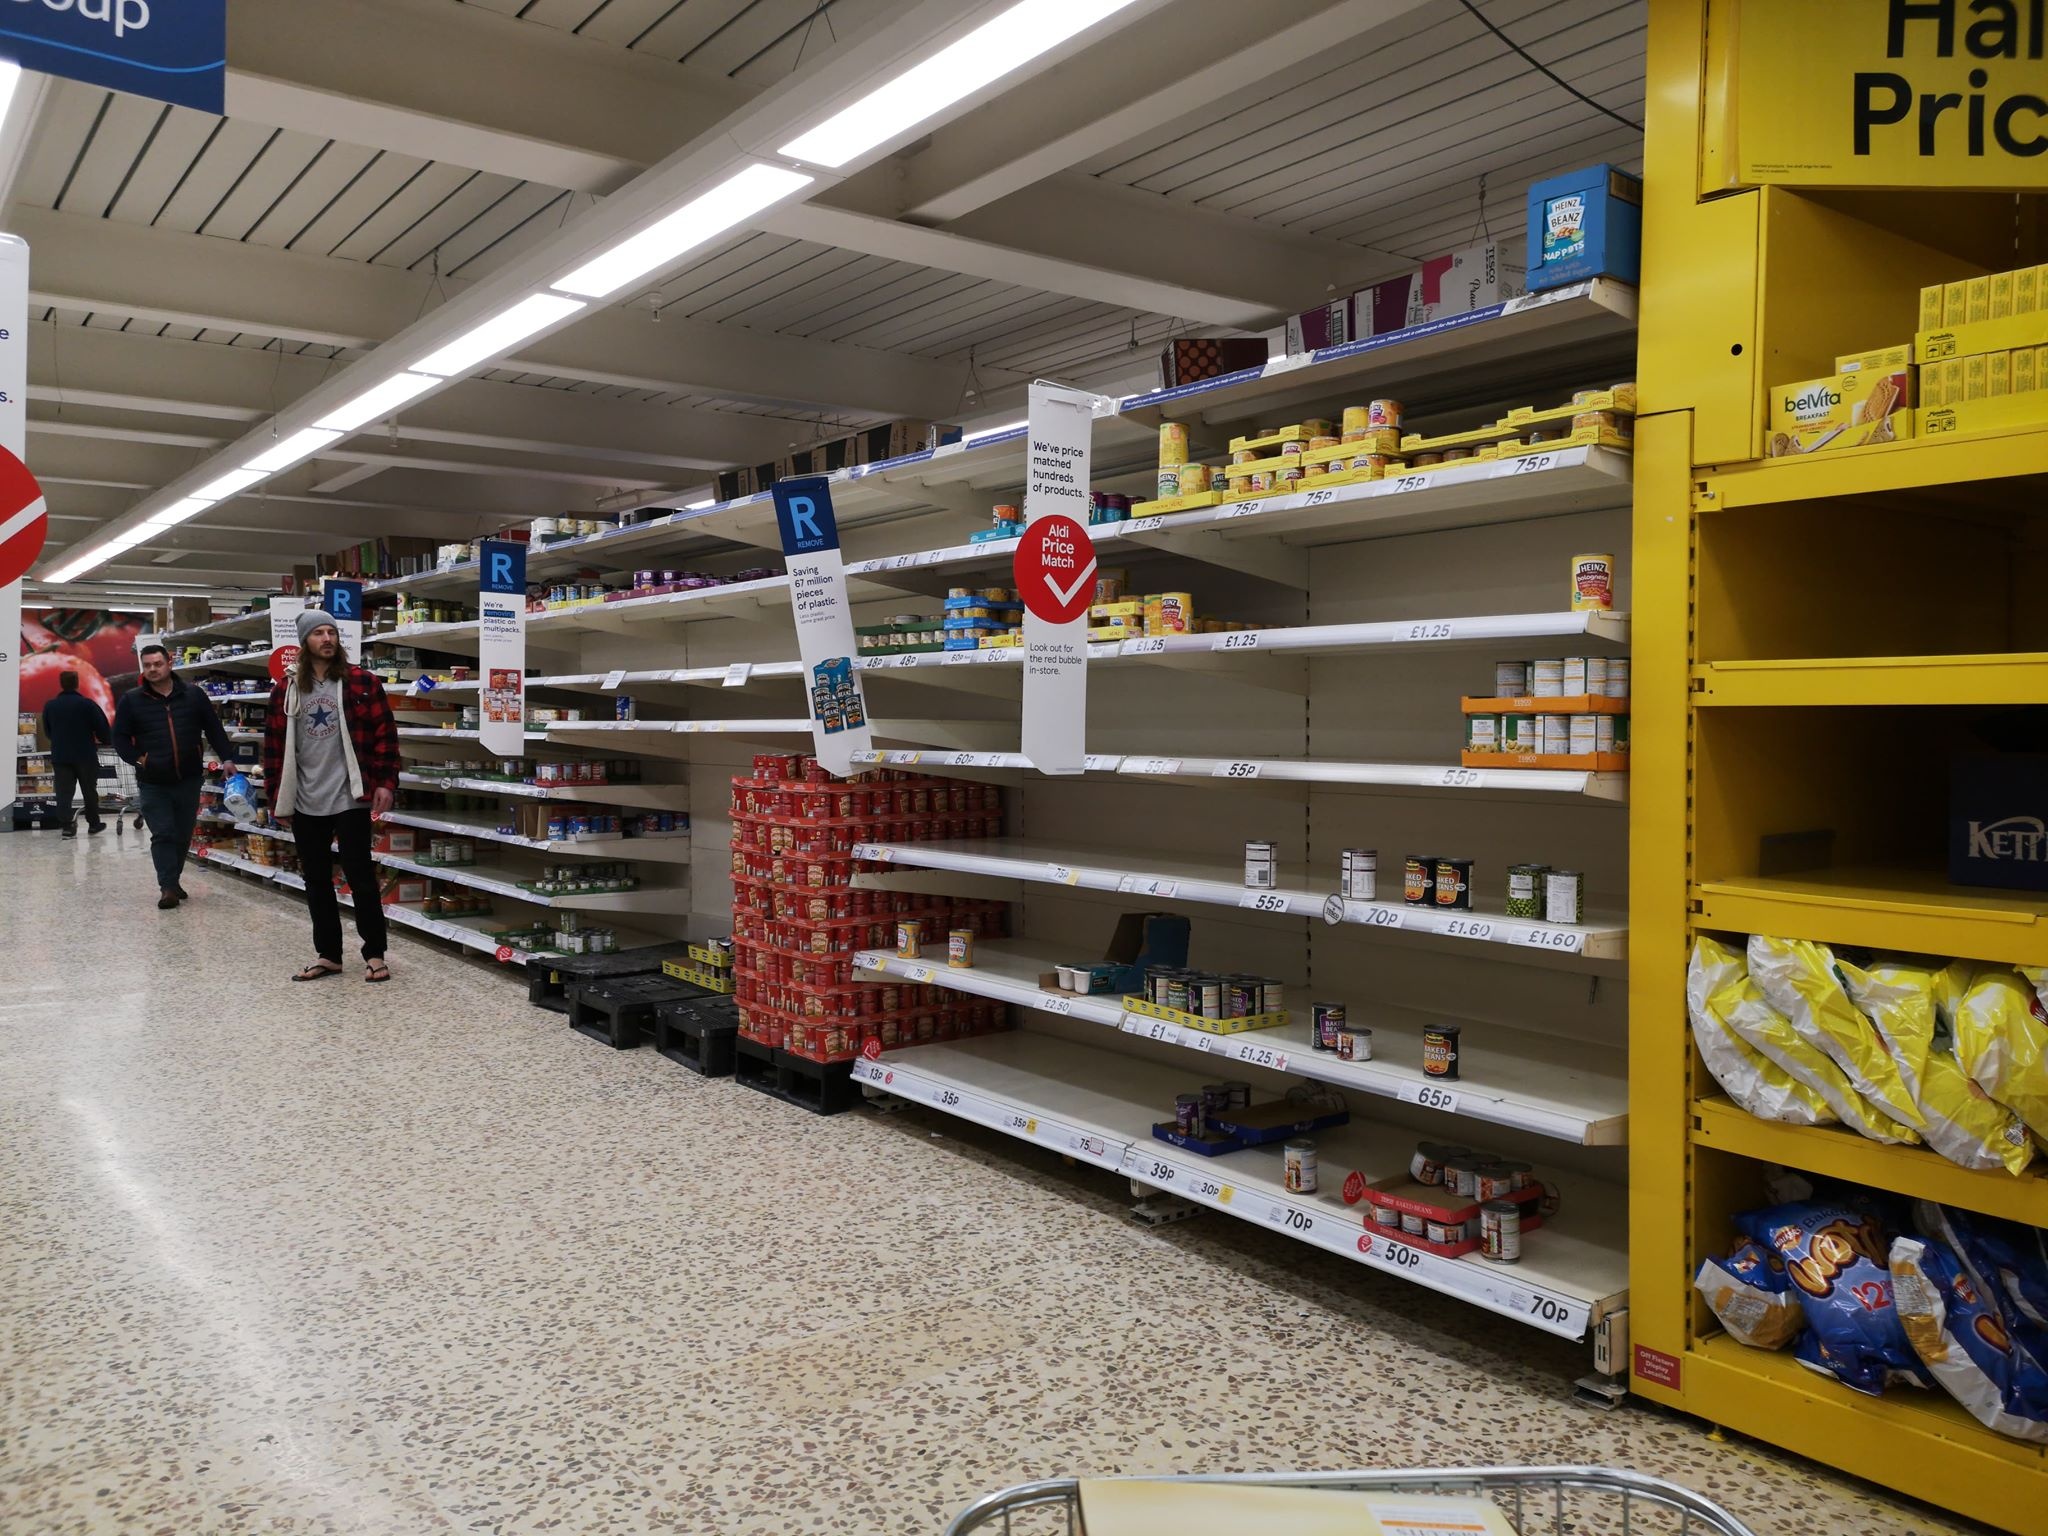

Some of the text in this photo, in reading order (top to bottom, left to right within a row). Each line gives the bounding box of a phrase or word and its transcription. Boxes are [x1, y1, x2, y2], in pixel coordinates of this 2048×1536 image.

[12, 0, 150, 37] up
[1853, 68, 2048, 157] Pric
[1555, 199, 1578, 212] HEINZ
[1551, 213, 1580, 228] BEANZ
[1796, 411, 1830, 421] BREAKFAST
[1034, 441, 1083, 457] We've price
[1033, 457, 1071, 469] matched
[1514, 455, 1550, 473] 75p
[1033, 469, 1074, 483] hundreds
[1033, 483, 1085, 498] of products.
[1394, 476, 1426, 493] 75p
[1305, 491, 1333, 505] 75p
[1233, 502, 1258, 516] 75p
[788, 496, 823, 539] R
[1135, 517, 1162, 529] £1.25
[1049, 524, 1069, 538] Aldi
[797, 539, 824, 549] REMOVE
[1042, 538, 1074, 554] Price
[491, 552, 514, 584] R
[896, 556, 907, 567] £1
[1042, 554, 1074, 568] Match
[1580, 563, 1605, 572] HEINZ
[793, 566, 819, 578] Saving
[1577, 574, 1608, 582] bolognese
[491, 583, 513, 591] REMOVE
[795, 575, 833, 588] 67 million
[333, 589, 352, 612] R
[796, 588, 824, 601] pieces
[484, 601, 503, 609] We're
[798, 597, 838, 611] of plastic.
[484, 610, 515, 619] removing
[1410, 624, 1451, 639] £1.25
[1136, 639, 1164, 651] £1.25
[1225, 634, 1257, 647] £1.25
[1030, 643, 1074, 653] Look out for
[988, 650, 1007, 661] 60p
[1030, 655, 1082, 665] the red bubble
[1029, 666, 1061, 675] in-store.
[303, 697, 338, 714] CONVERSE
[307, 723, 337, 737] ALL STAR
[955, 753, 974, 765] 60p
[1228, 763, 1256, 777] 55p
[1442, 769, 1478, 785] 55p
[1968, 816, 2048, 862] KETT
[1255, 894, 1284, 910] 55p
[1325, 906, 1340, 921] TESCO
[1365, 908, 1398, 926] 70p
[1448, 920, 1490, 937] £1.60
[1528, 930, 1576, 947] £1.60
[1045, 999, 1069, 1012] £2.50
[1150, 1024, 1166, 1039] £1
[1198, 1037, 1211, 1048] £1
[1240, 1047, 1272, 1064] £1.25
[870, 1068, 883, 1080] 13p
[941, 1091, 959, 1106] 35p
[1418, 1087, 1452, 1108] 65p
[1013, 1116, 1026, 1129] 35p
[1150, 1162, 1174, 1180] 39p
[1201, 1182, 1219, 1197] 30p
[1395, 1200, 1413, 1210] BAKED
[1414, 1204, 1432, 1214] BEANS
[1285, 1208, 1313, 1231] 70p
[1385, 1243, 1420, 1268] 50p
[1530, 1295, 1569, 1323] 70p
[1640, 1350, 1674, 1367] Off Fixture
[1643, 1366, 1671, 1381] Location
[1645, 1360, 1669, 1374] Display
